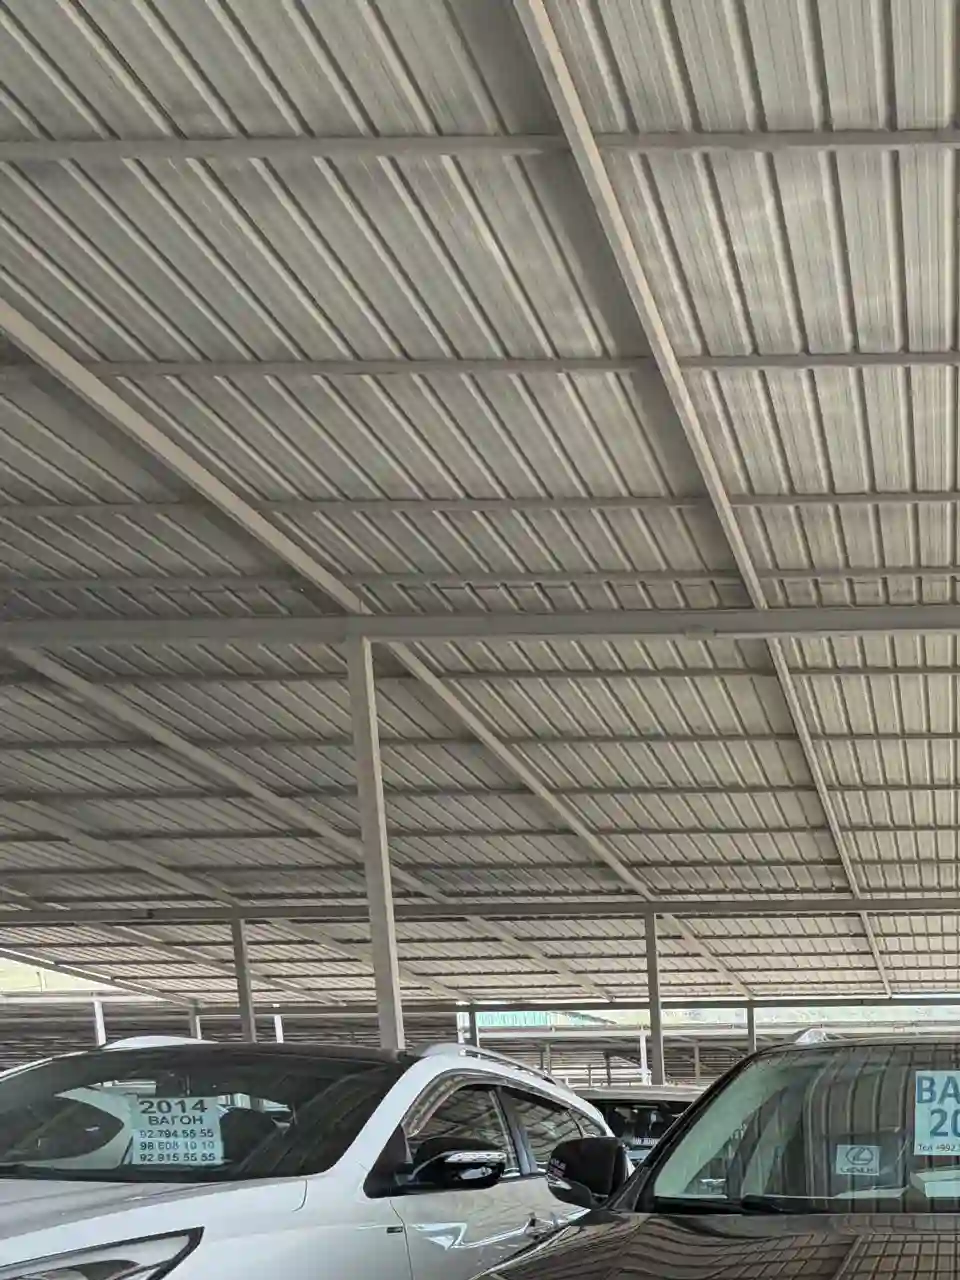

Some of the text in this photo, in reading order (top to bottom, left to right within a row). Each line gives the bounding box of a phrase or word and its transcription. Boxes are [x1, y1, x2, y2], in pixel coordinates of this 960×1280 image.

[138, 1099, 208, 1114] 2014
[148, 1115, 203, 1126] ВАГОН
[199, 1128, 214, 1138] 55
[201, 1140, 215, 1150] 10
[183, 1152, 198, 1162] 55
